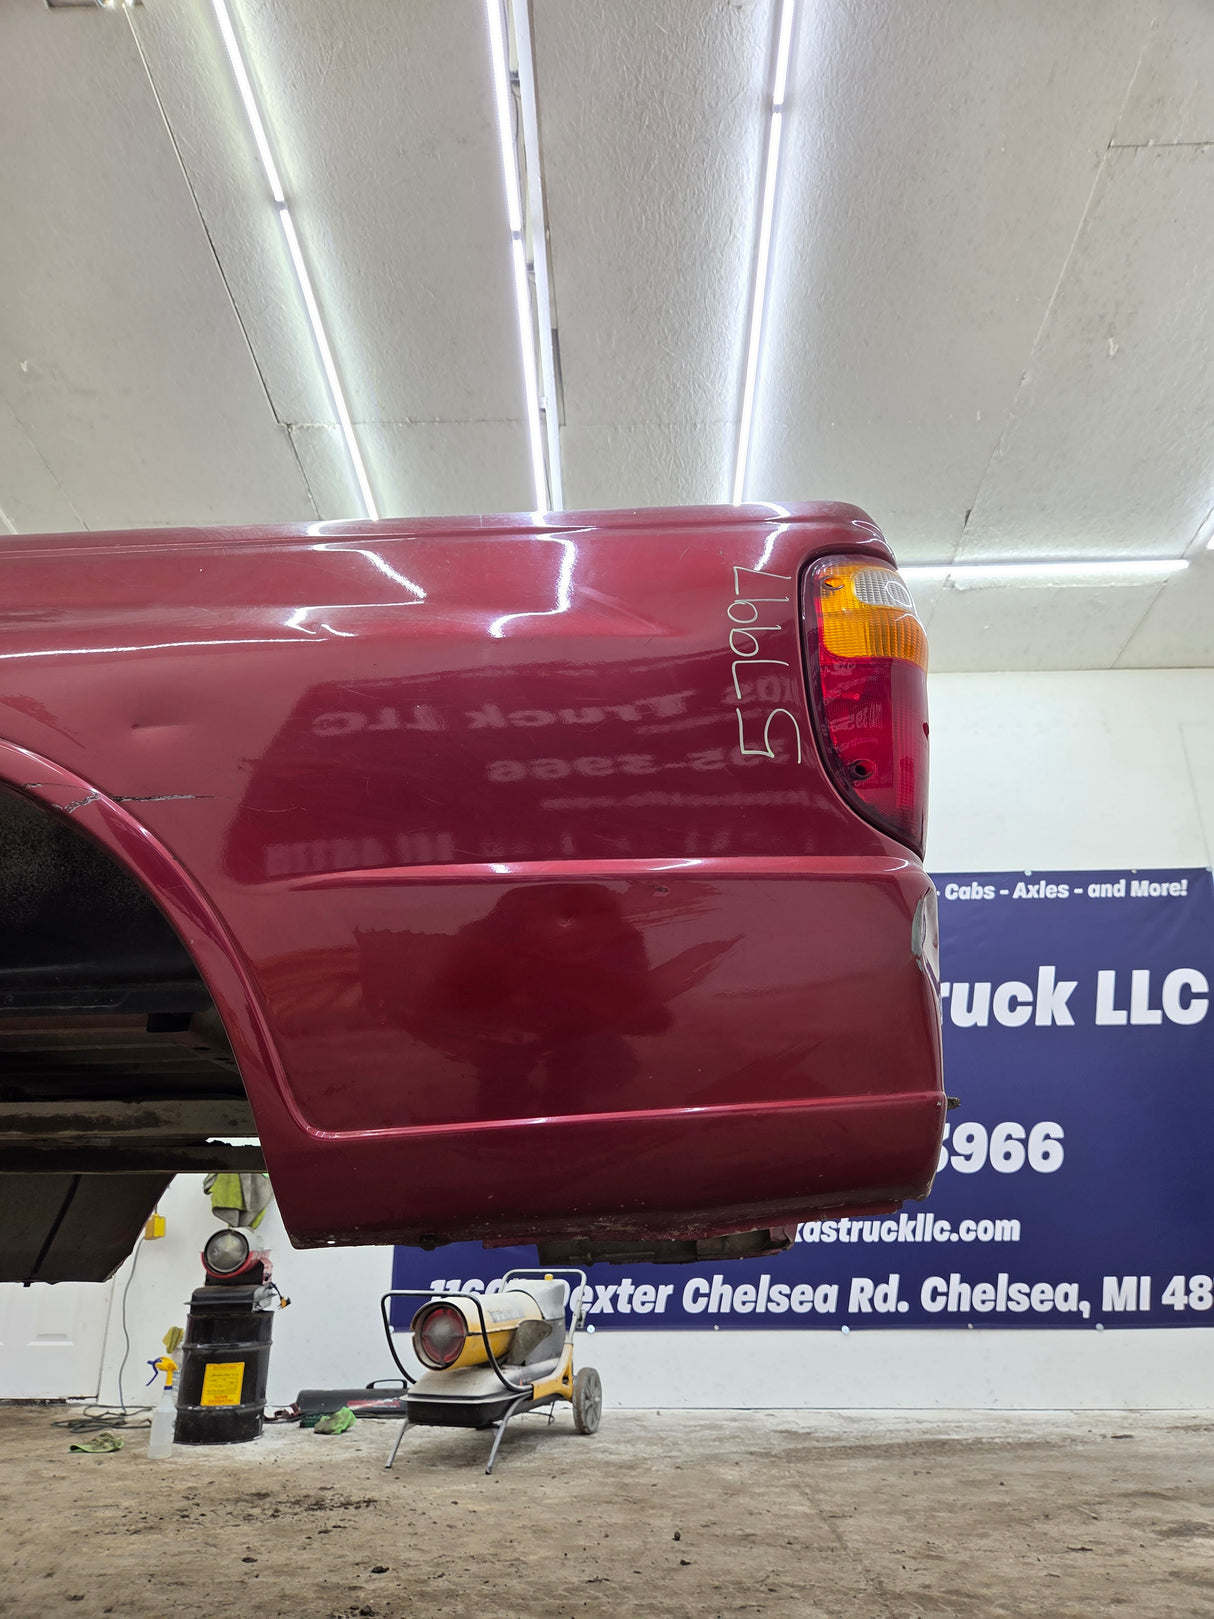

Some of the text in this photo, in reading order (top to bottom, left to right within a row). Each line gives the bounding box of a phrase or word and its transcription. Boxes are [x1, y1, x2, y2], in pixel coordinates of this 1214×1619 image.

[727, 566, 802, 764] 57997
[945, 881, 996, 900] Cabs
[1012, 880, 1070, 899] Axles
[1087, 879, 1126, 898] and
[1130, 879, 1189, 897] More!
[1095, 967, 1210, 1026] LLC
[682, 1274, 840, 1313] Chelsea
[848, 1273, 910, 1313] Rd.
[920, 1272, 1091, 1319] Chelsea,
[1101, 1275, 1152, 1311] MI
